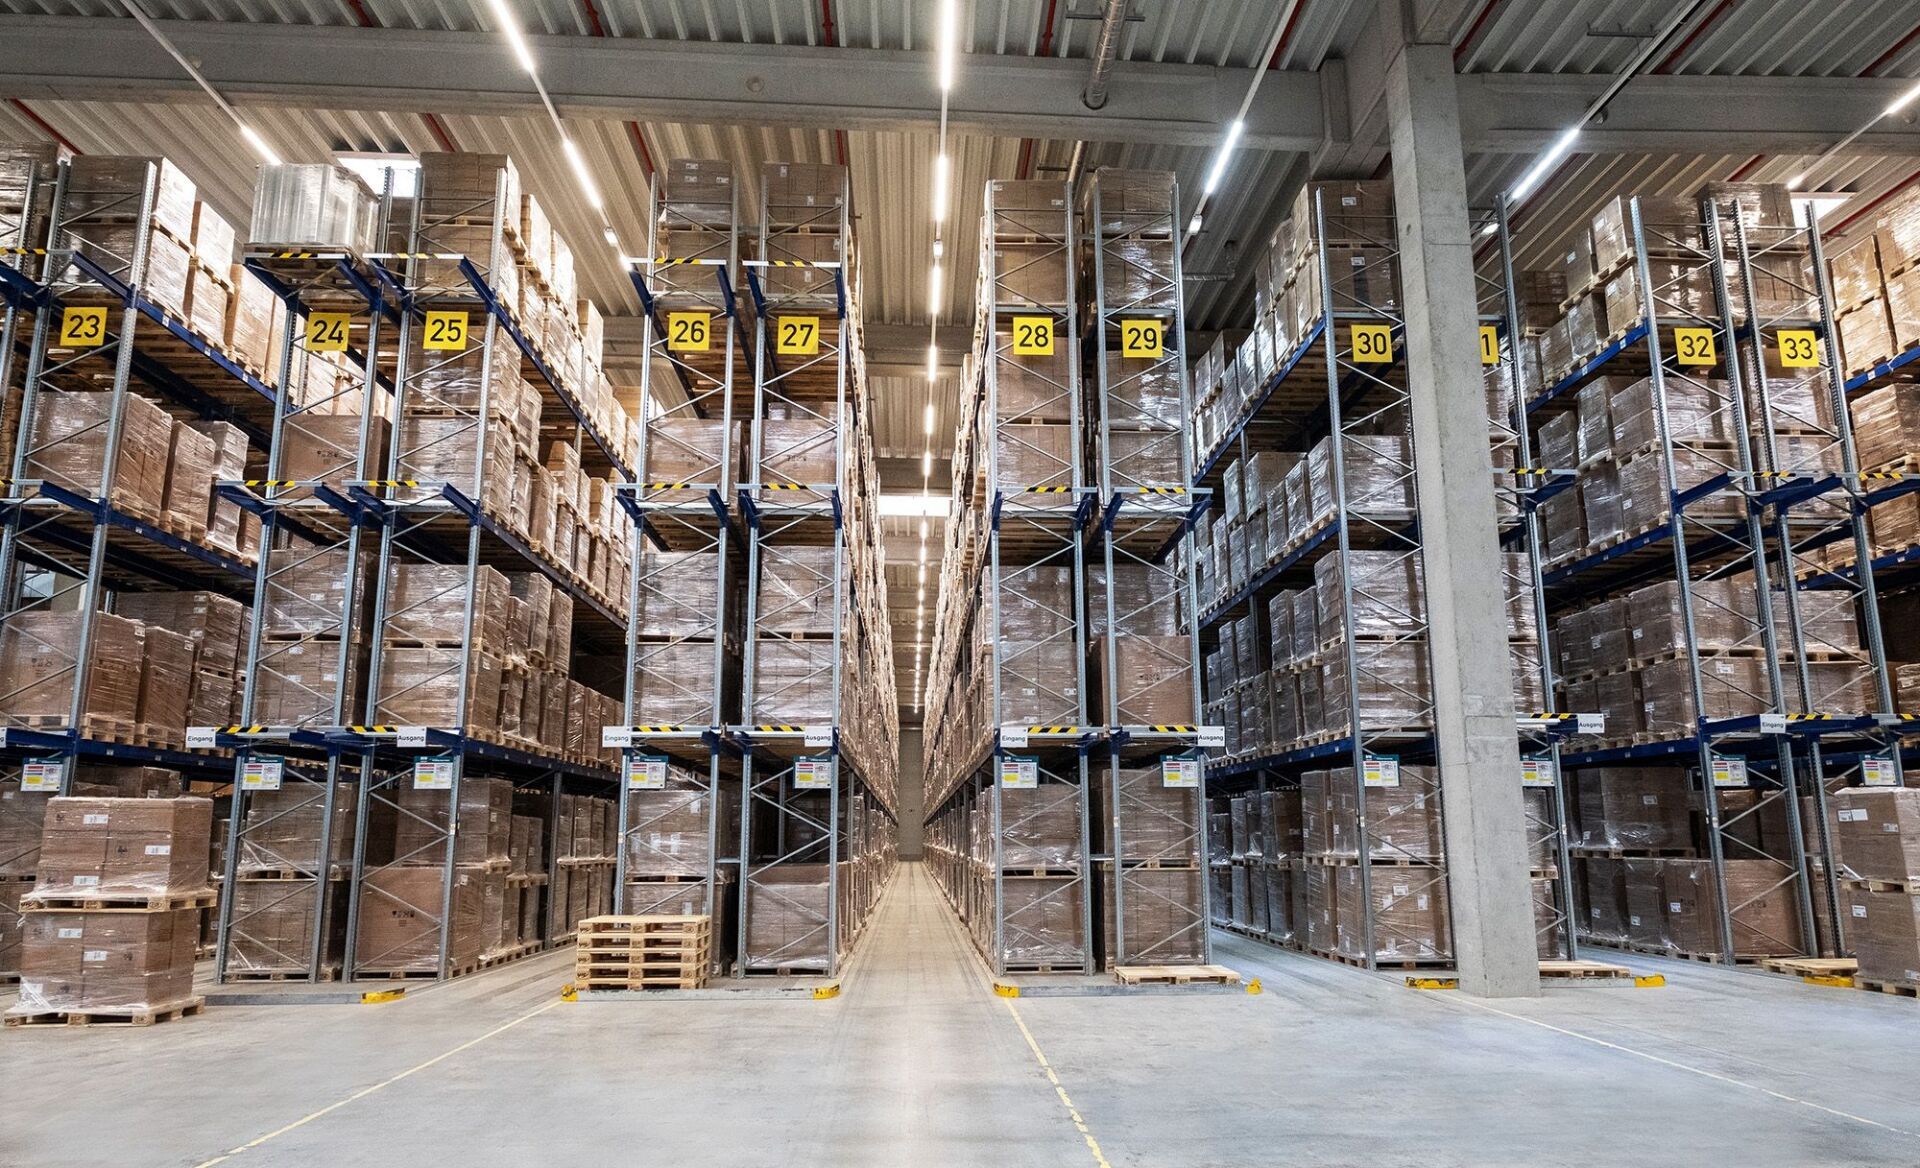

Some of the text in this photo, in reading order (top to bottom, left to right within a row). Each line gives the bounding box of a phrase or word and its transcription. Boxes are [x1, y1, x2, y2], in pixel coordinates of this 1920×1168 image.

[67, 314, 100, 339] 23
[311, 319, 344, 344] 24
[430, 318, 462, 343] 25
[674, 320, 705, 343] 26
[783, 323, 814, 347] 27
[1019, 325, 1049, 348] 28
[1127, 327, 1157, 350] 29
[1357, 332, 1387, 355] 30
[1681, 335, 1711, 358] 32
[1784, 337, 1813, 360] 33
[1579, 721, 1603, 729] Ausgang
[1762, 721, 1784, 729] Eingang
[187, 735, 213, 743] Eingang
[398, 735, 425, 743] Ausgang
[604, 735, 629, 743] Eingang
[805, 734, 831, 742] Ausgang
[1001, 735, 1026, 743] Eingang
[1198, 734, 1224, 742] Ausgang
